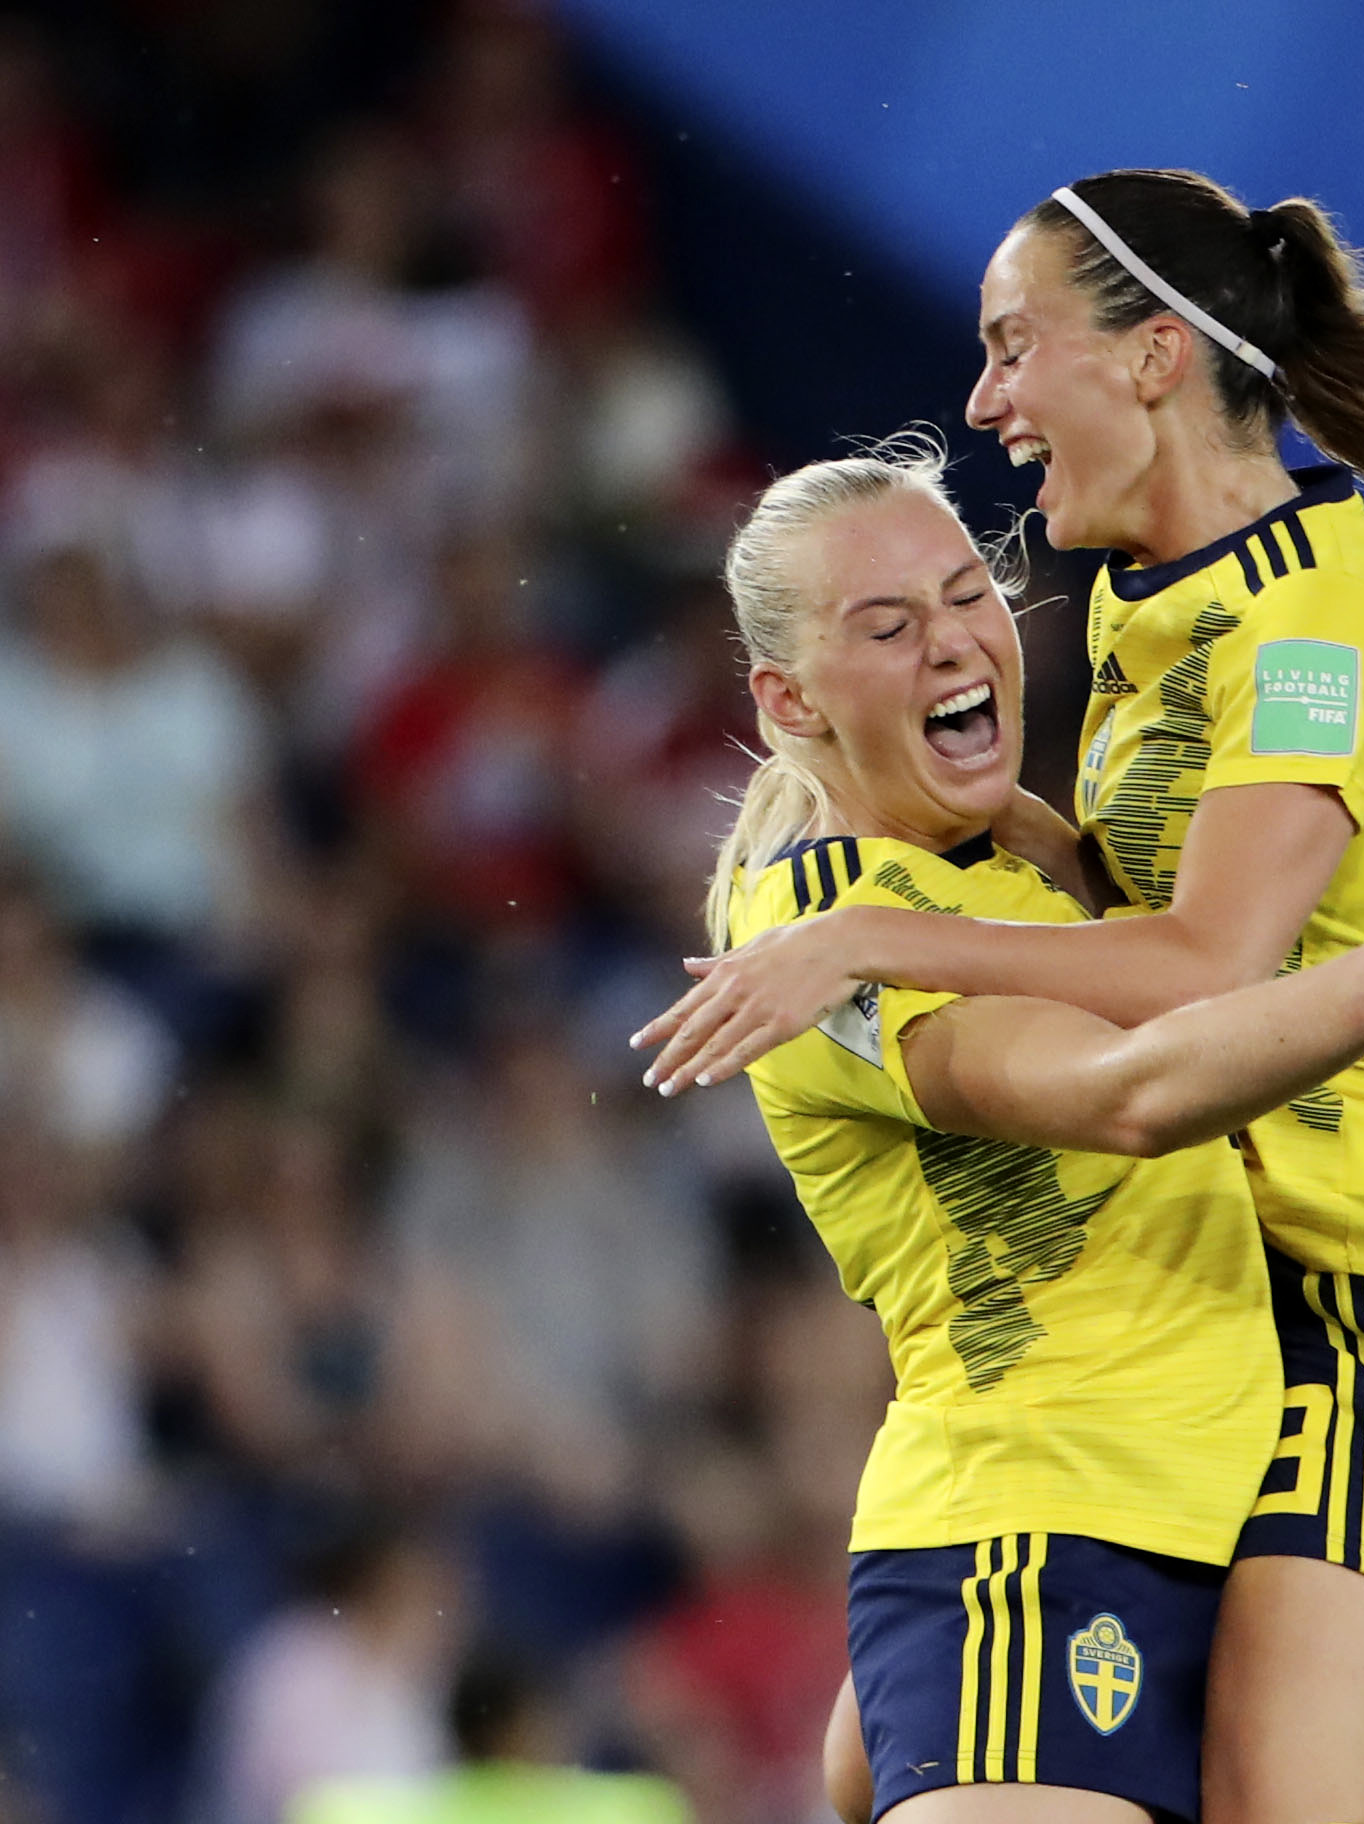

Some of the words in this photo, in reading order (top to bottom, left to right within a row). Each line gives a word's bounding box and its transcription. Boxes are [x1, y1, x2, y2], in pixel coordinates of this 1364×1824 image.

[1263, 669, 1350, 685] LIVING
[1264, 682, 1348, 698] FOOTBALL
[1308, 708, 1347, 725] FIFA
[1082, 1647, 1130, 1665] SVERIGE
